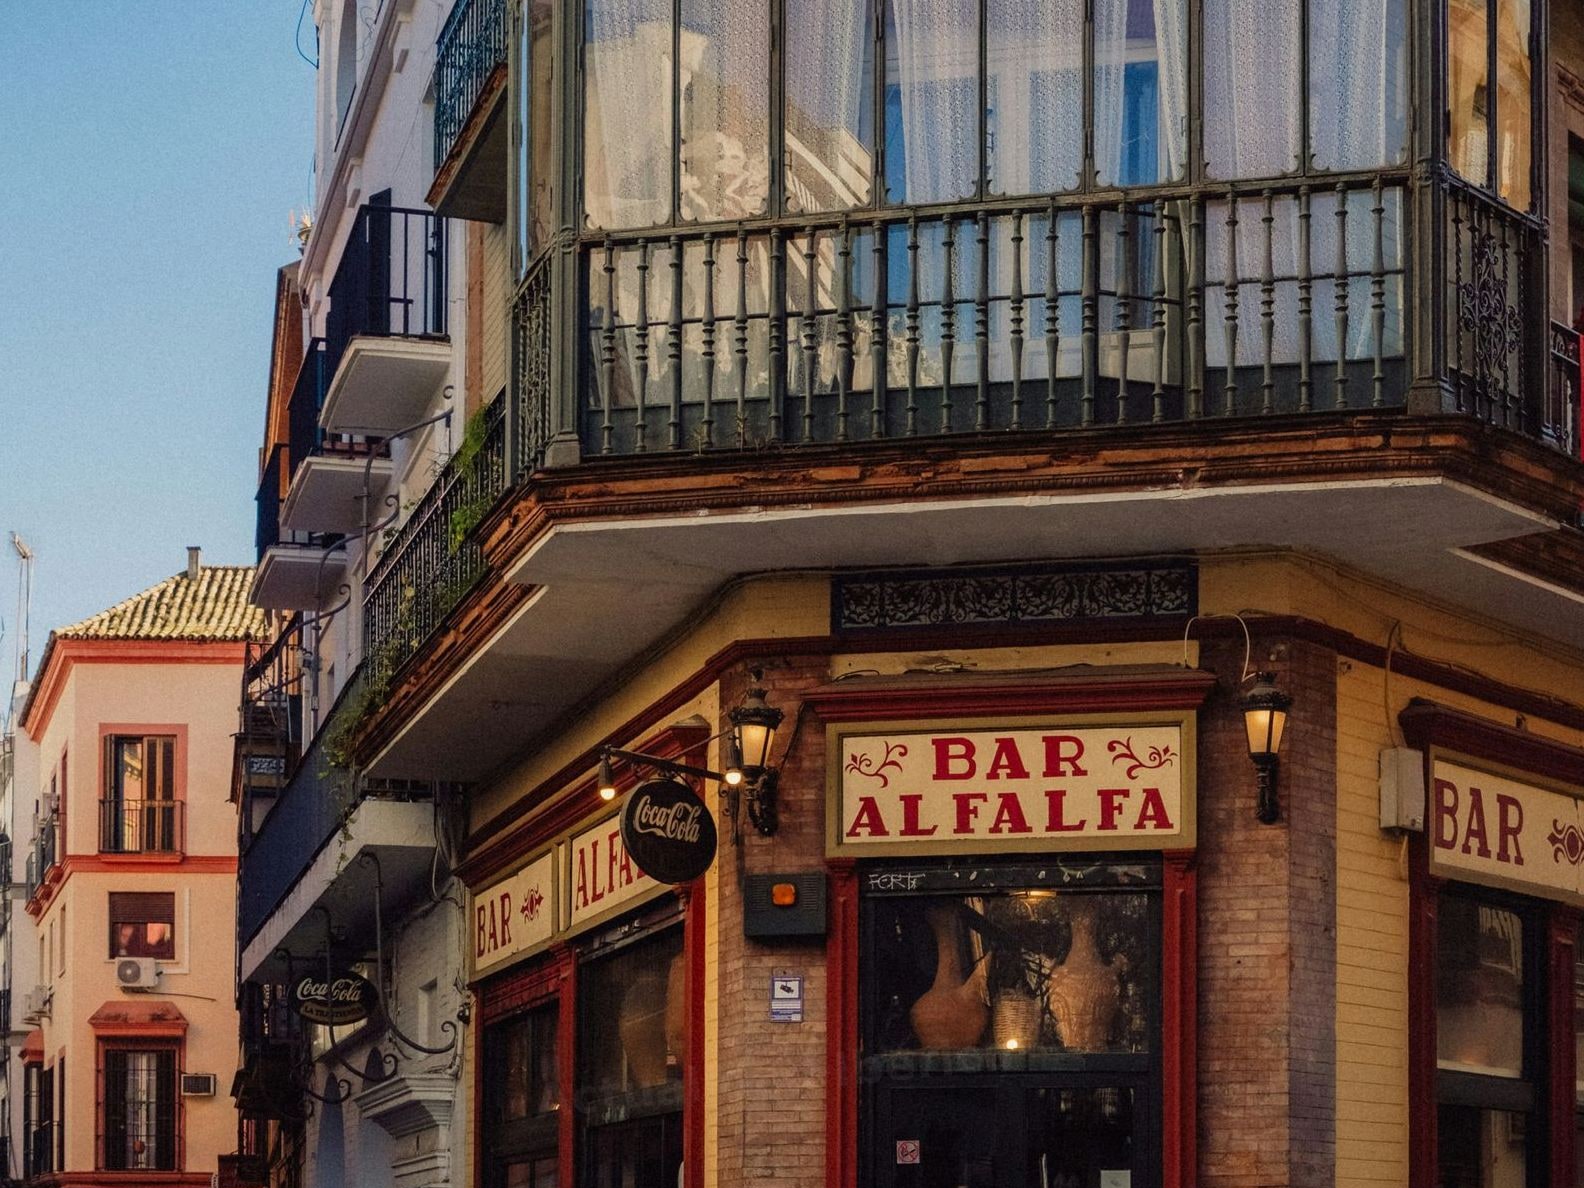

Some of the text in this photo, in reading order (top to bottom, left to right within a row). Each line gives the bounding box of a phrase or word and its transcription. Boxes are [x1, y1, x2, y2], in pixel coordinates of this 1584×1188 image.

[931, 735, 1088, 781] BAR
[846, 788, 1174, 838] ALFALFA
[1434, 777, 1524, 866] BAR
[476, 829, 646, 958] BAR ALFA
[296, 977, 364, 1002] CocaCola
